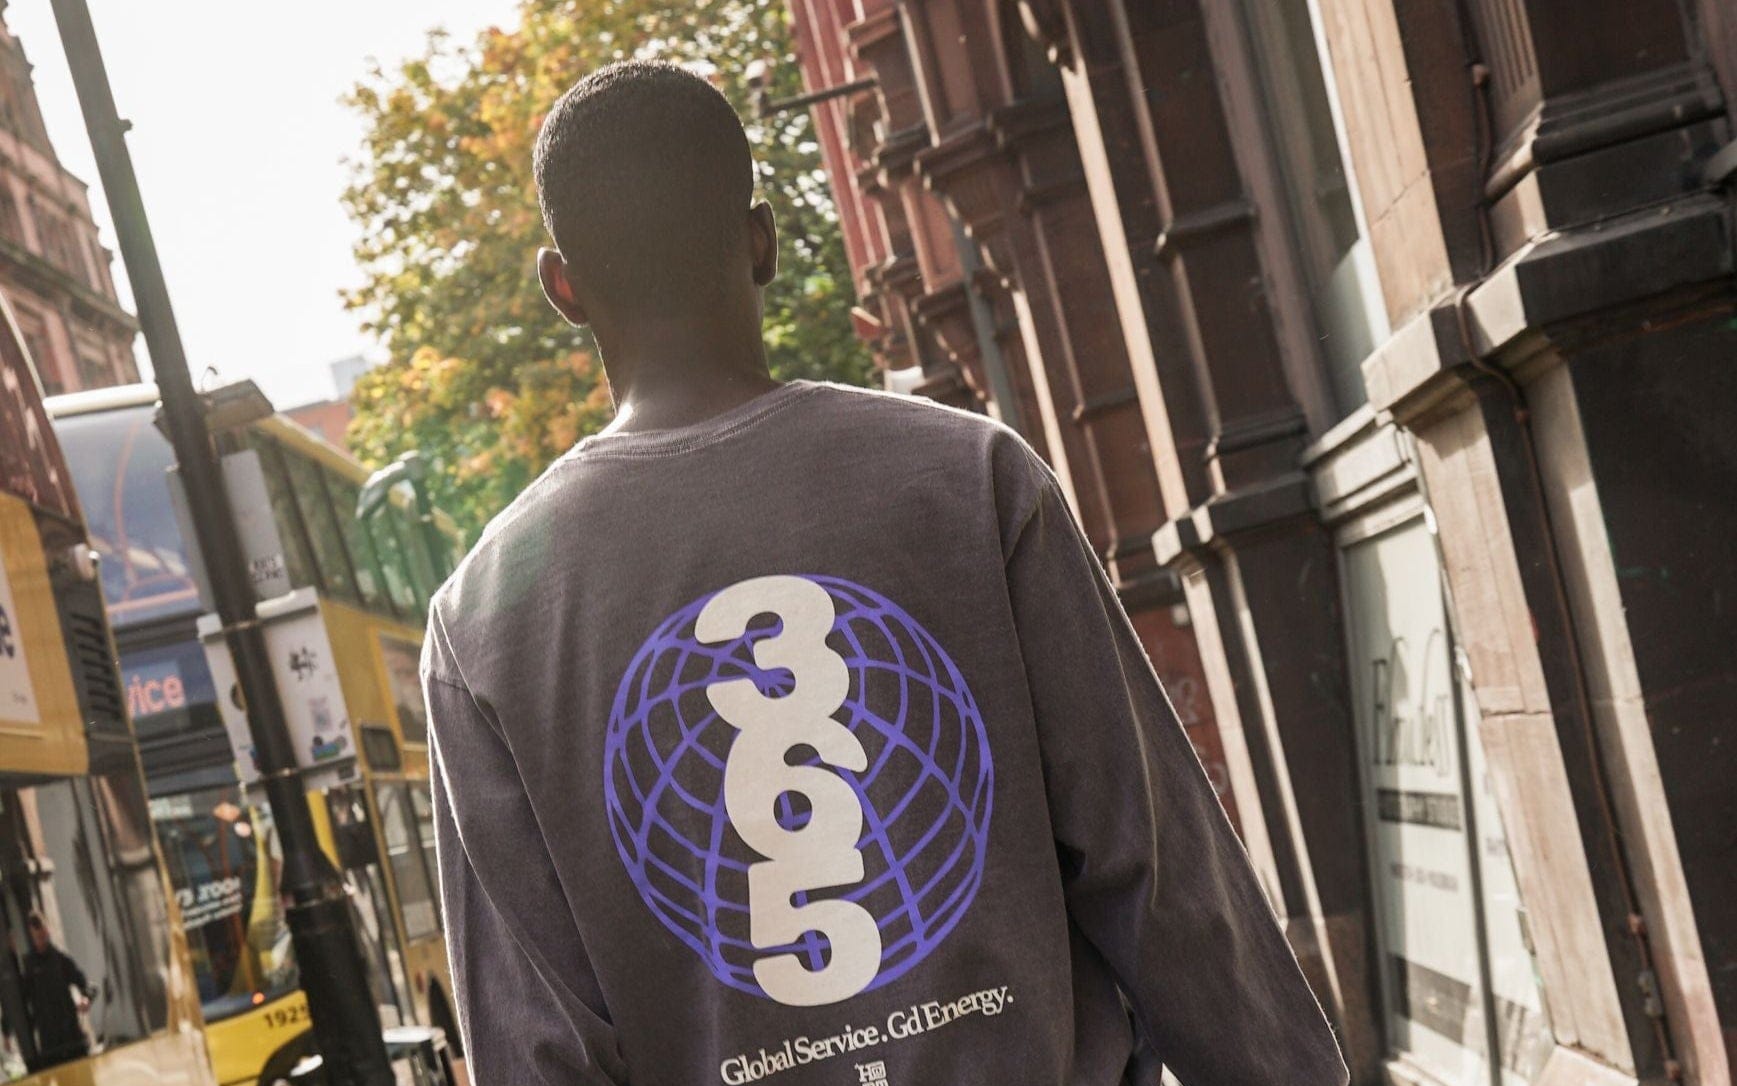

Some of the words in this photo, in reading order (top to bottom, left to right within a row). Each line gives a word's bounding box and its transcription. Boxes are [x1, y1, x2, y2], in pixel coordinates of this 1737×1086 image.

[695, 575, 883, 1007] 365
[720, 1039, 797, 1086] Global
[794, 1024, 889, 1065] Service.
[887, 1005, 925, 1040] Gd
[920, 986, 1014, 1031] Energy.
